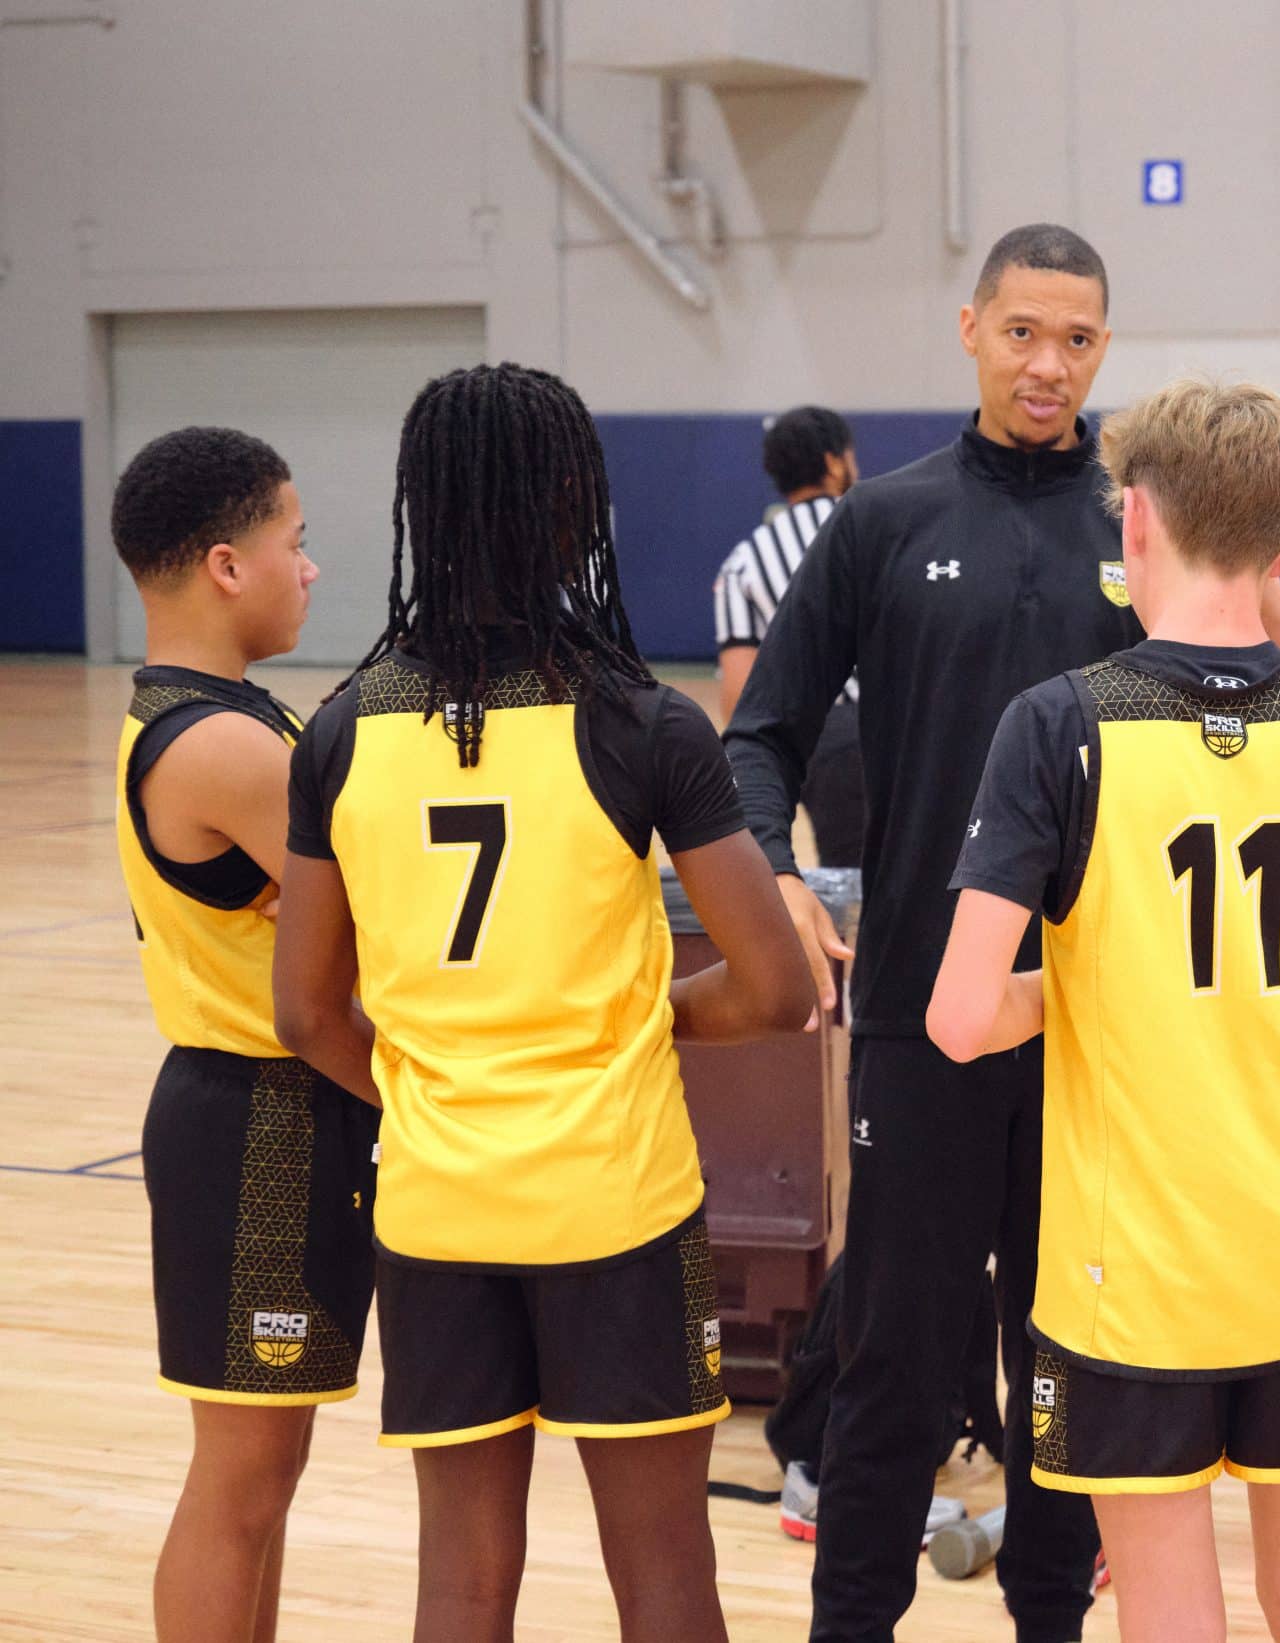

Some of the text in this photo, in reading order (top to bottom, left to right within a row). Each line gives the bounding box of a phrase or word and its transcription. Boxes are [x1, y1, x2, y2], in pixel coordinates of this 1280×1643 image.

[1149, 164, 1177, 200] 8
[1204, 713, 1242, 727] PRO
[1205, 723, 1244, 733] SKILLS
[424, 800, 510, 966] 7
[253, 1311, 308, 1329] PRO
[253, 1326, 307, 1338] SKILLS
